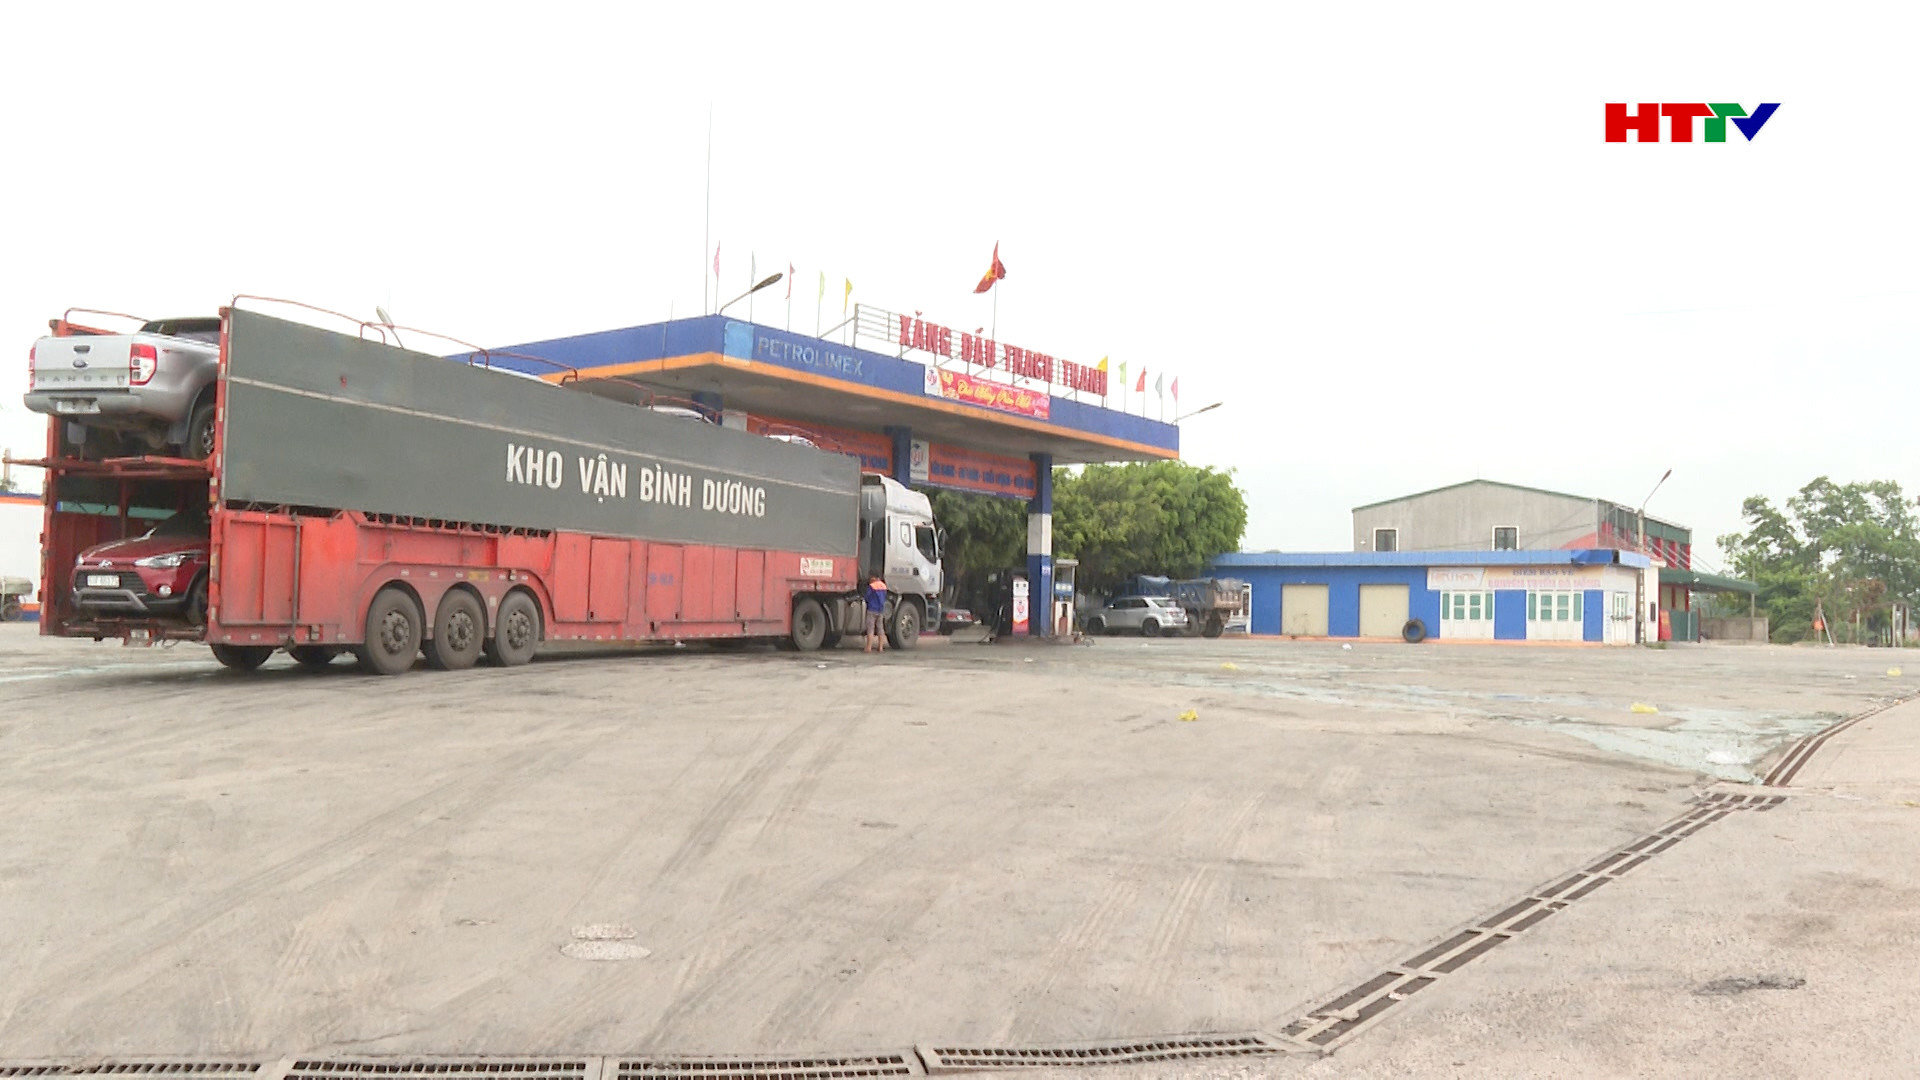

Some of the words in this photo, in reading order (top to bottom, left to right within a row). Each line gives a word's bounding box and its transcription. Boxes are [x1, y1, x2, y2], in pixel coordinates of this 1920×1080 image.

[757, 336, 863, 376] PETROLIMEX
[1062, 359, 1108, 396] THANH
[506, 443, 563, 490] KHO
[578, 453, 627, 504] VẬN
[639, 463, 692, 508] BÌNH
[702, 479, 765, 517] DƯƠNG
